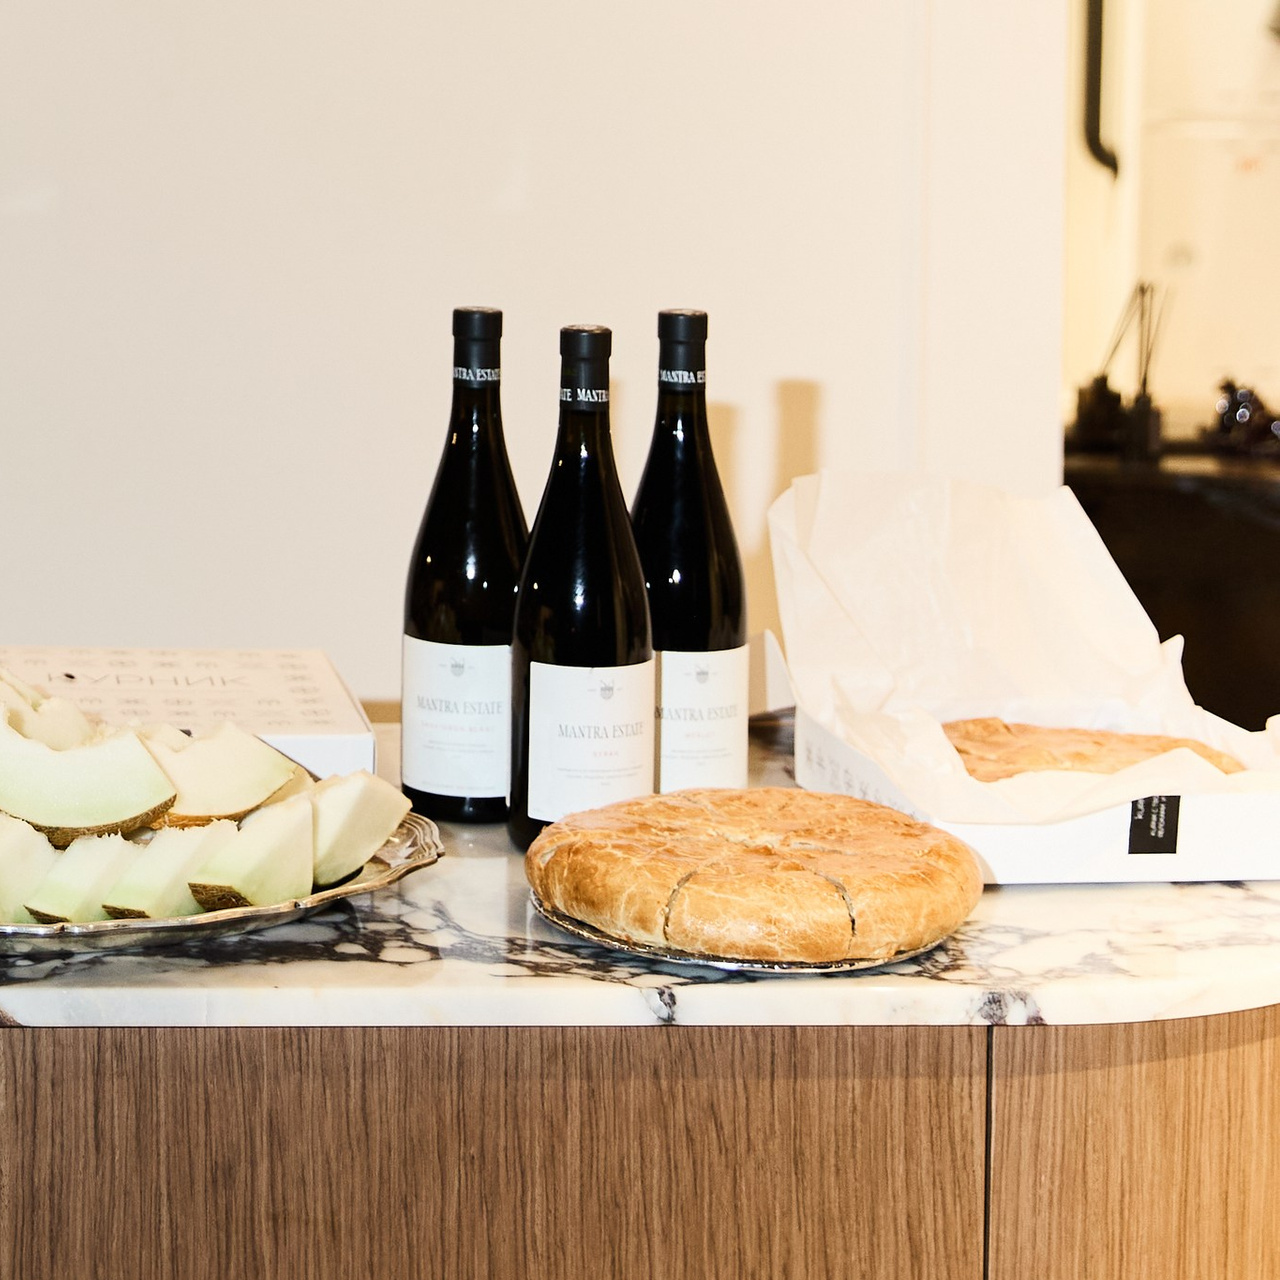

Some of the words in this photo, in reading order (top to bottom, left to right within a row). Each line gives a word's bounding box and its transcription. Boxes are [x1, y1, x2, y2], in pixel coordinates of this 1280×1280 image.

[417, 695, 460, 714] MANTRA
[464, 701, 503, 715] ESTATE
[558, 724, 609, 739] MANTRA
[612, 722, 644, 738] ESTATE
